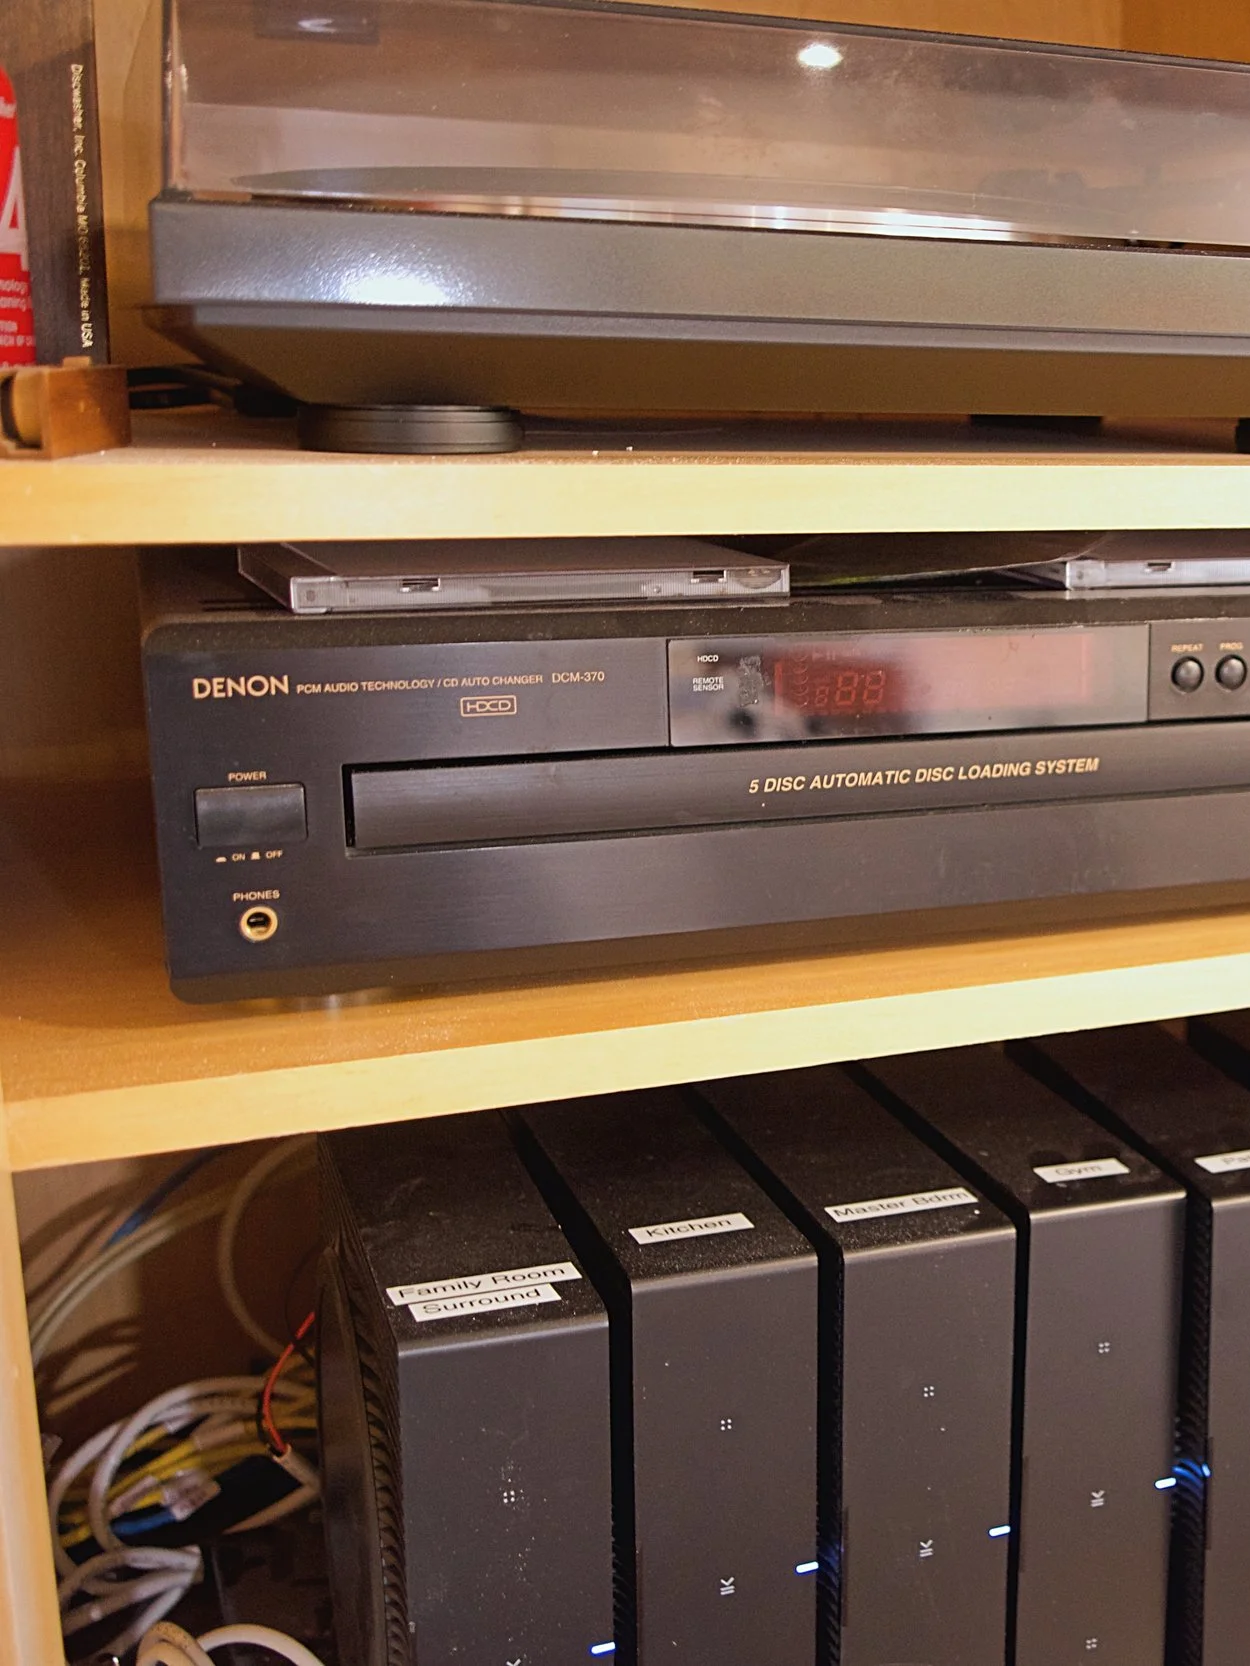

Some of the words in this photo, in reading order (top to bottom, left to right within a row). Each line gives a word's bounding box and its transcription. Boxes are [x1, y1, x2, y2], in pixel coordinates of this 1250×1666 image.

[74, 158, 88, 213] Columbia
[80, 278, 91, 308] Made
[81, 310, 90, 321] in
[81, 322, 94, 348] USA
[1171, 643, 1203, 653] REPEAT
[1219, 641, 1244, 651] PROG
[696, 654, 719, 663] HDCD
[296, 682, 322, 695] PCM
[323, 681, 358, 693] AUDIO
[360, 679, 435, 692] TECHNOLOGY
[443, 677, 458, 689] CD
[460, 676, 490, 688] AUTO
[492, 674, 544, 686] CHANGER
[551, 671, 605, 684] DCM-370
[692, 676, 724, 685] REMOTE
[192, 674, 290, 699] DENON
[692, 683, 724, 692] SENSOR
[466, 699, 512, 713] HDCD
[228, 770, 268, 782] POWER
[749, 778, 760, 794] 5
[763, 775, 806, 793] DISC
[809, 768, 912, 791] AUTOMATIC
[915, 765, 955, 784] DISC
[957, 761, 1032, 781] LOADING
[1035, 757, 1100, 776] SYSTEM
[231, 852, 246, 862] ON
[265, 849, 284, 860] OFF
[232, 889, 281, 902] PHONES
[1054, 1162, 1103, 1178] Gym
[833, 1199, 906, 1219] Master
[912, 1190, 970, 1207] Bdrm
[645, 1217, 732, 1239] Kitchen
[399, 1279, 482, 1299] Family
[492, 1266, 566, 1285] Room
[422, 1287, 541, 1315] Surround
